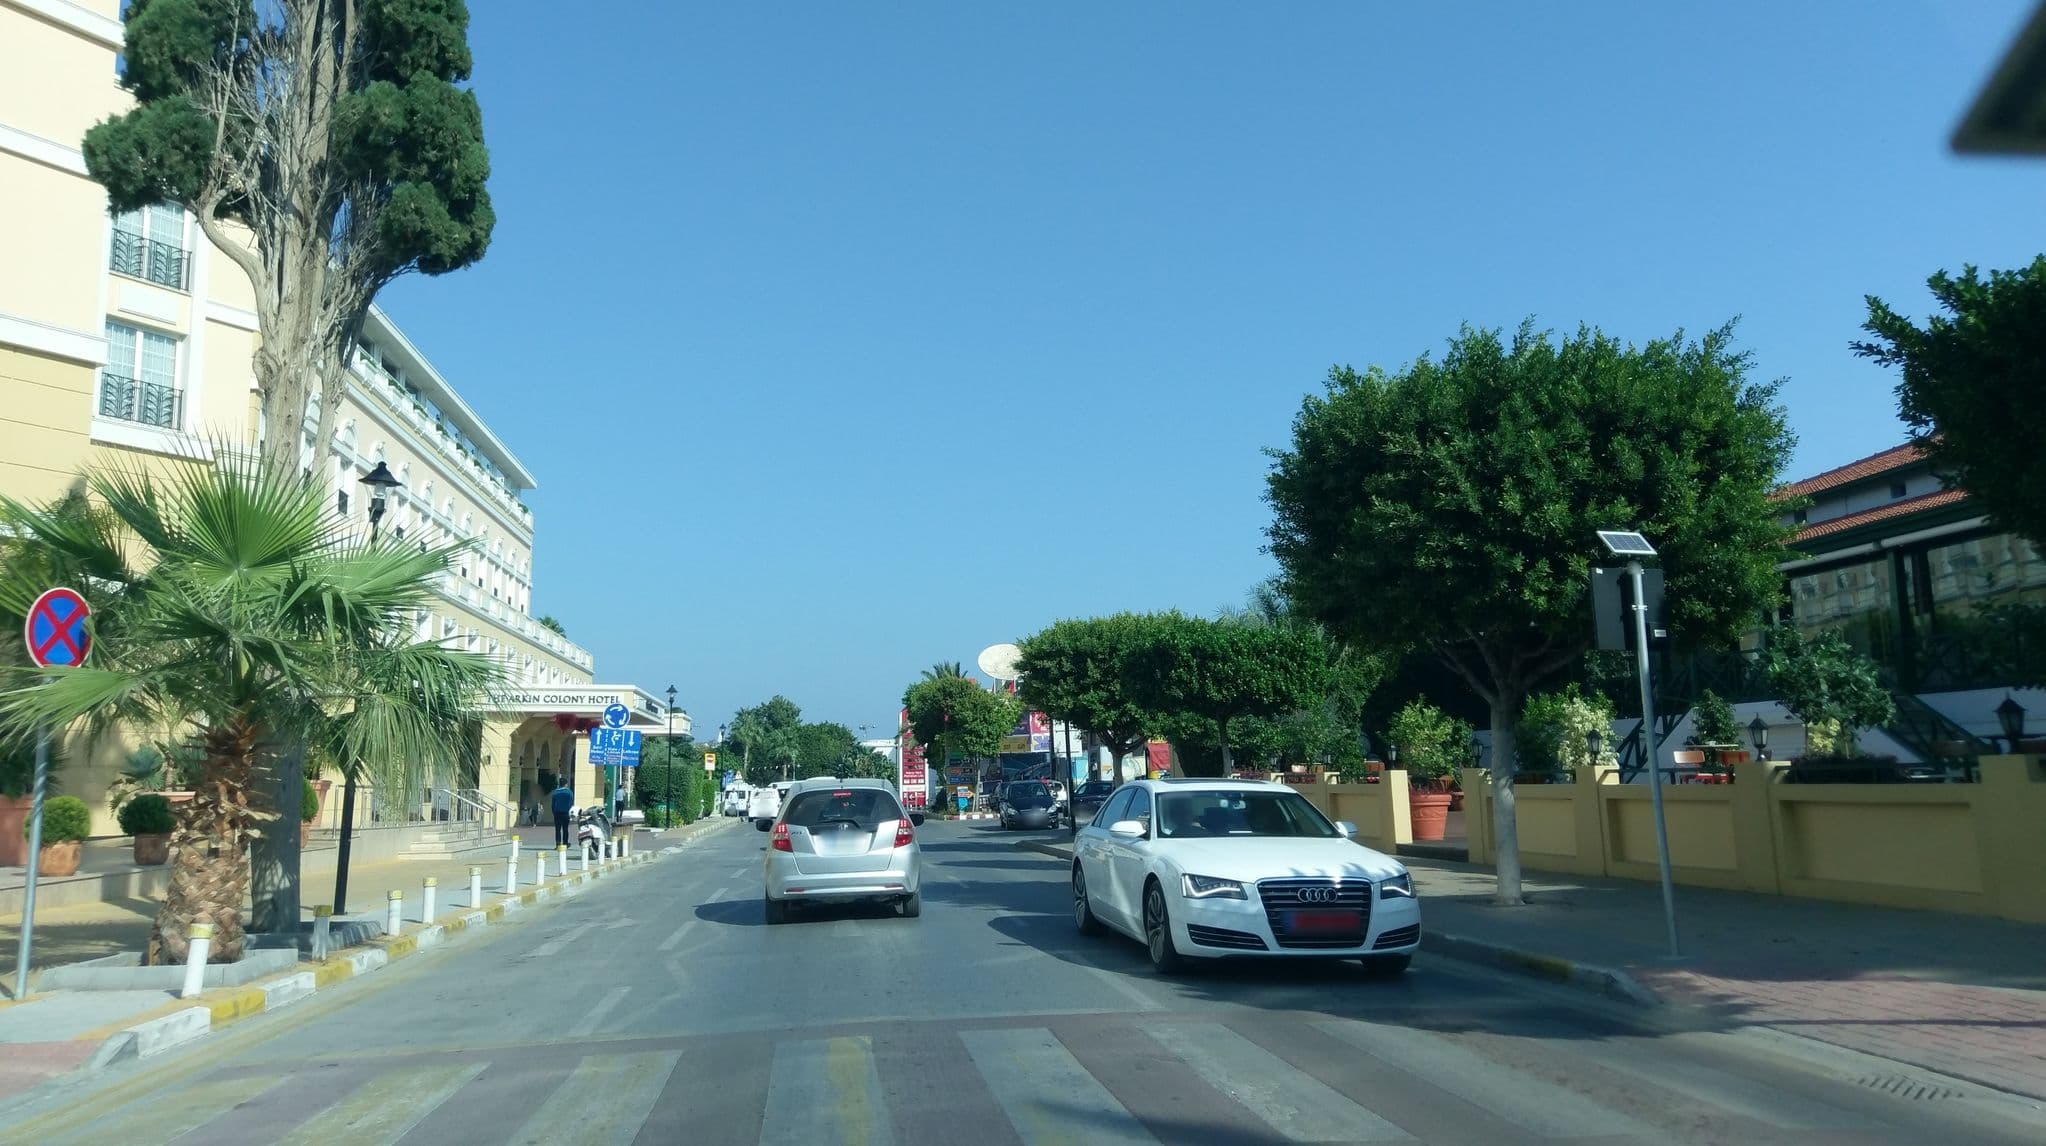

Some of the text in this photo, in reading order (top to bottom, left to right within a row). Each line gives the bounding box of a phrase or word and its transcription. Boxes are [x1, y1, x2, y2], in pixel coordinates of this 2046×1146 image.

[508, 695, 540, 703] ARKIN
[543, 695, 586, 704] COLONY
[588, 695, 620, 704] HOTEL
